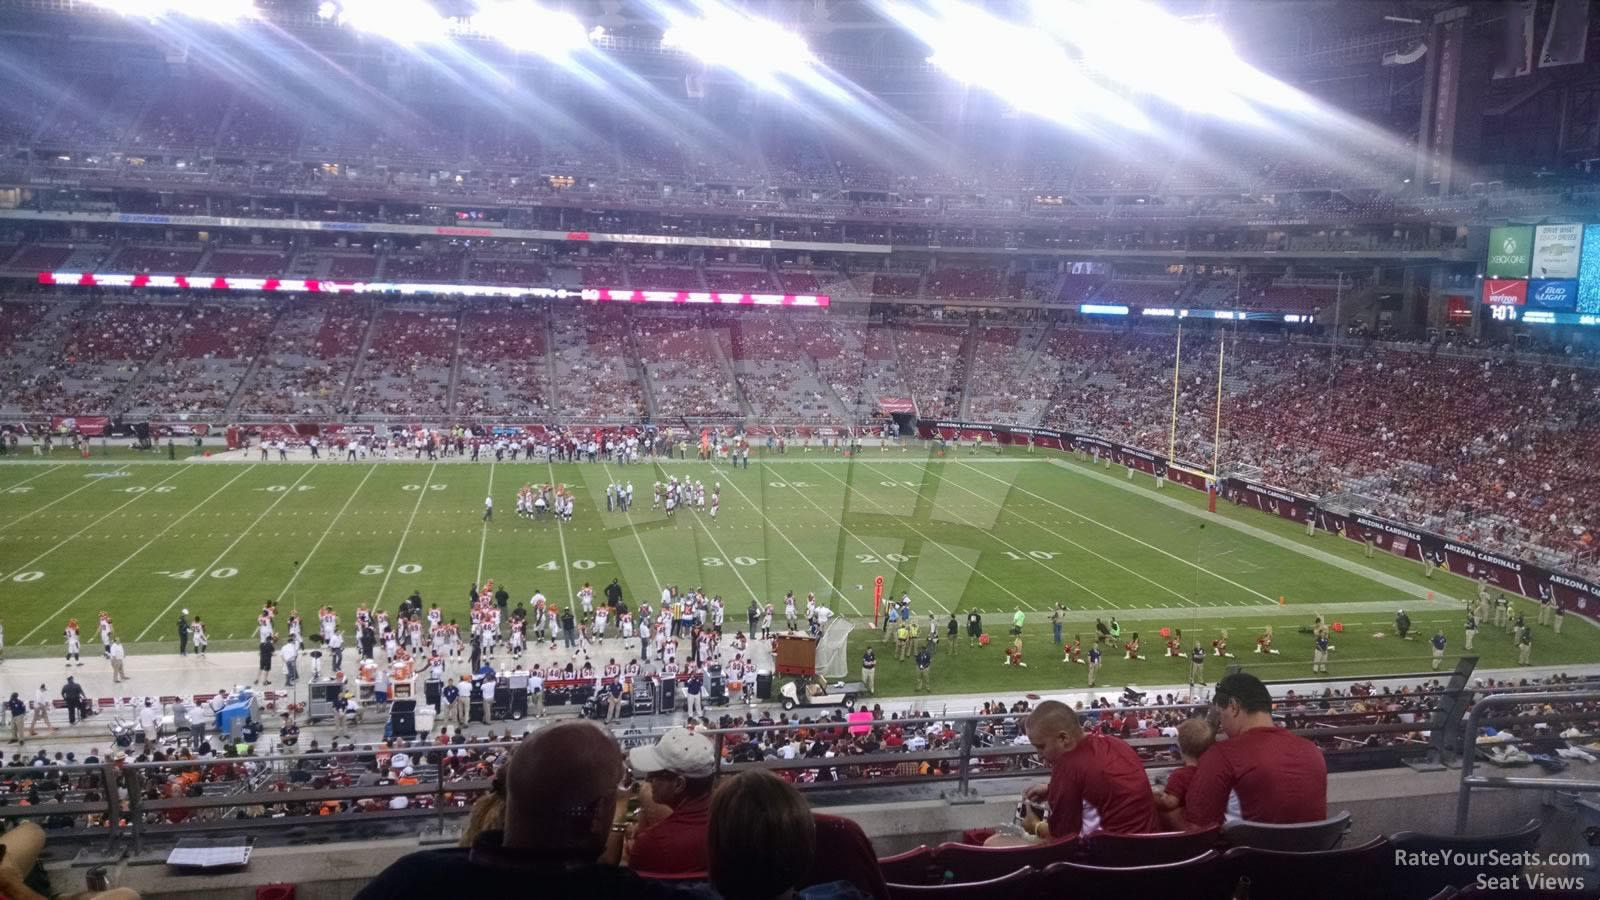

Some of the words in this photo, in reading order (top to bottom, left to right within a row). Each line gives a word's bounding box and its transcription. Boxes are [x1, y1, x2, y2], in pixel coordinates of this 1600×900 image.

[1491, 255, 1512, 264] XBOX
[1512, 255, 1526, 264] ONE
[1489, 294, 1518, 303] verizon
[1246, 484, 1267, 495] ARIZONA
[1267, 490, 1294, 502] CARDINALS
[1357, 517, 1384, 530] ARIZONA
[1385, 525, 1421, 541] CARDINALS
[1444, 543, 1476, 558] ARIZONA
[1478, 553, 1521, 572] CARDINALS
[1549, 574, 1589, 592] ARIZONA
